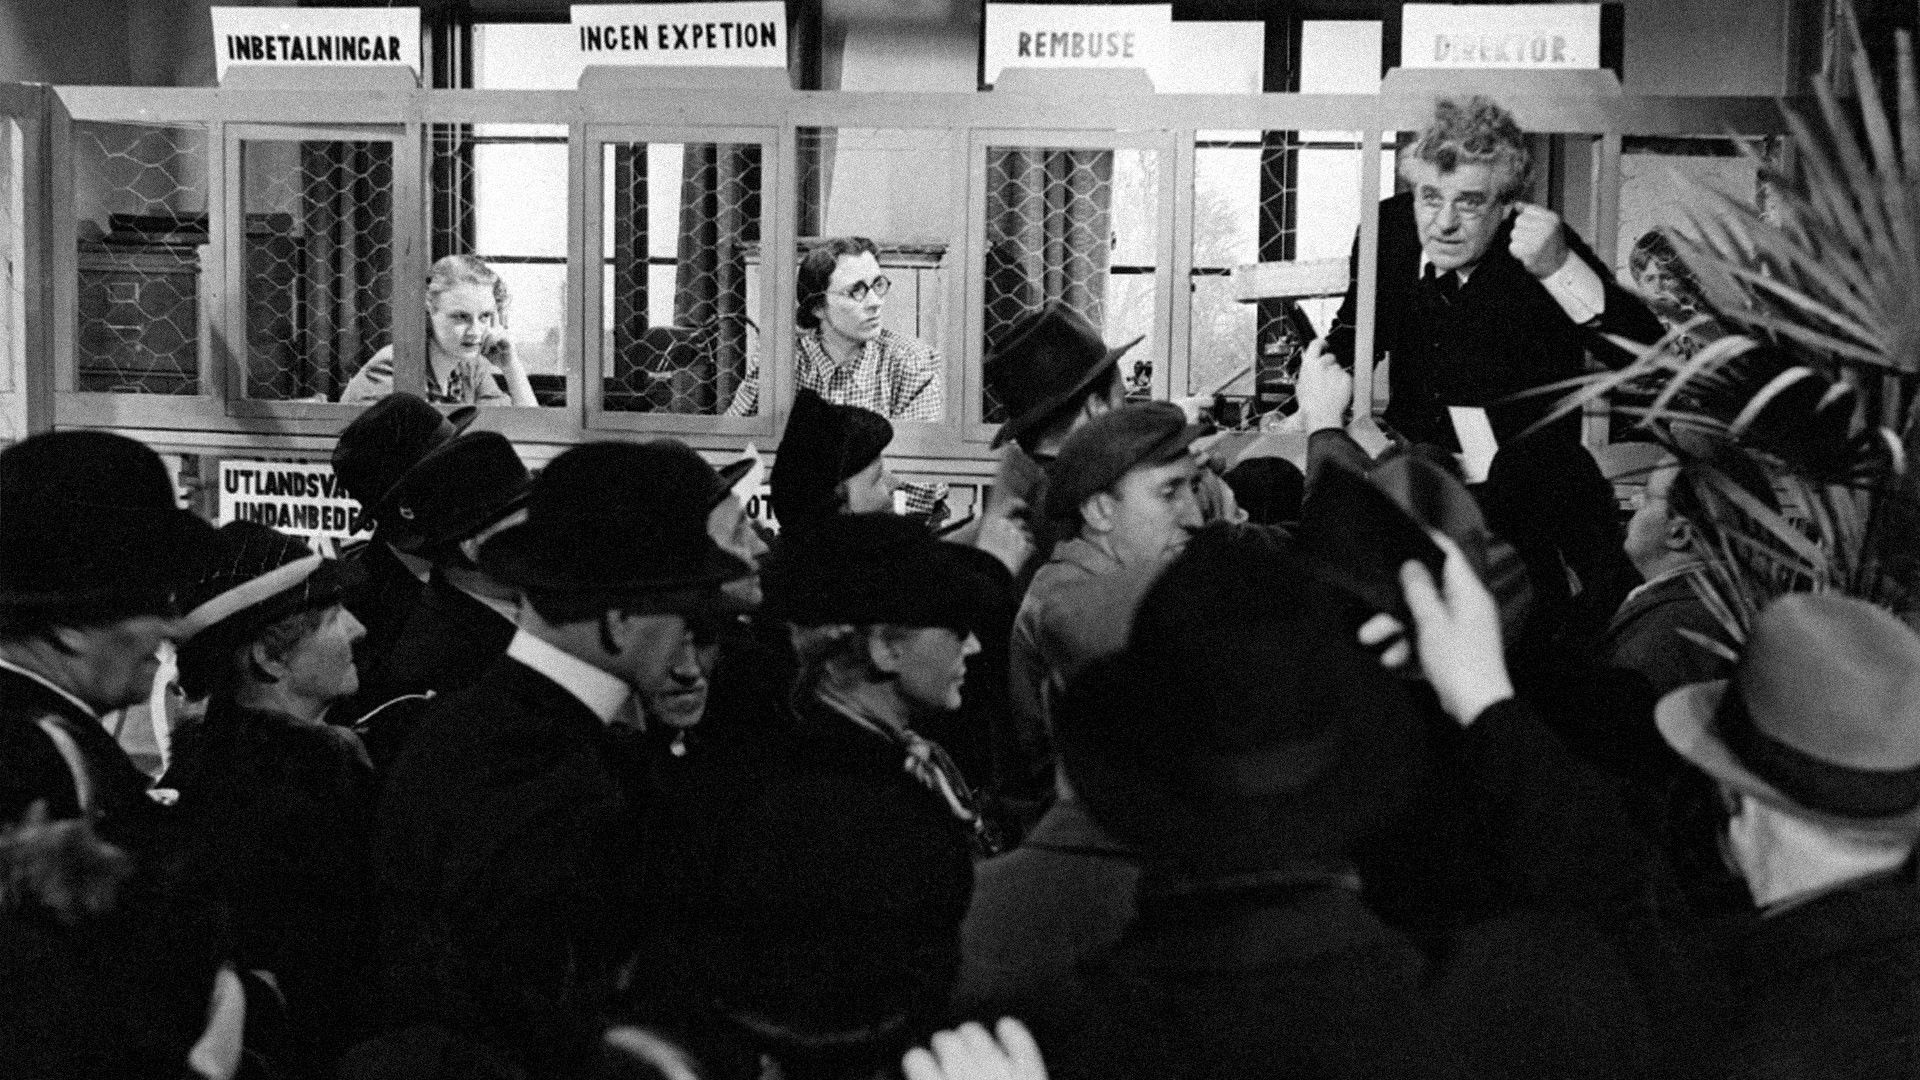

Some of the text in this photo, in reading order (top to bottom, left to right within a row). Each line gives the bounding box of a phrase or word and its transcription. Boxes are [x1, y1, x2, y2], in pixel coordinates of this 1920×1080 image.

[228, 36, 401, 61] INBETALNINGAR
[580, 22, 777, 51] INGEN EXPETION
[1018, 31, 1136, 58] REMBUSE
